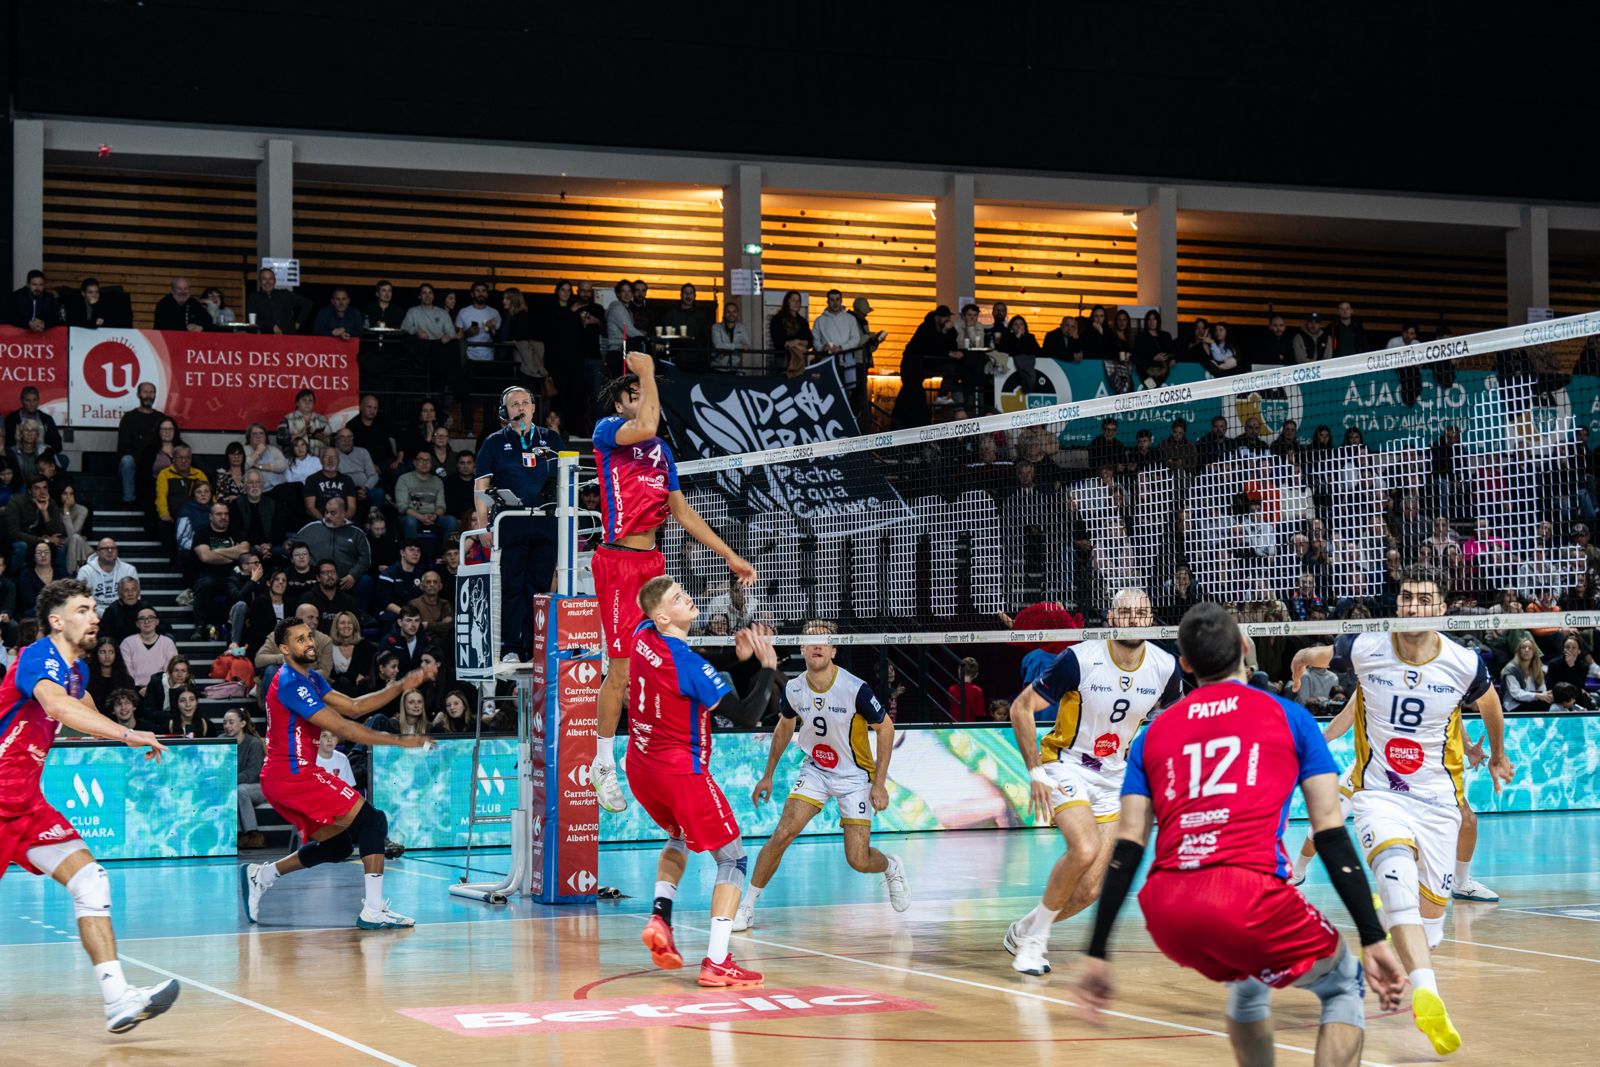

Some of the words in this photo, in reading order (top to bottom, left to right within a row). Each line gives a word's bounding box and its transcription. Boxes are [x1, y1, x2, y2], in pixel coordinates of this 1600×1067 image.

[1425, 340, 1469, 360] CORSICA
[186, 350, 243, 365] PALAIS
[249, 352, 281, 366] DES
[286, 353, 348, 369] SPORTS
[1292, 366, 1321, 382] CORSE
[184, 371, 203, 386] ET
[210, 372, 243, 387] DES
[248, 374, 349, 391] SPECTACLES
[1159, 387, 1192, 404] CORSICA
[1057, 405, 1080, 419] CORSE
[954, 422, 980, 436] CORSICA
[875, 435, 893, 447] CORSE
[648, 444, 662, 468] 4
[792, 447, 814, 459] CORSICA
[772, 464, 845, 484] Pêche
[319, 481, 344, 492] PEAK
[562, 600, 599, 609] Carrefour
[1341, 621, 1364, 633] Gamm
[1365, 620, 1380, 632] vert
[1447, 617, 1472, 630] Gamm
[1473, 617, 1490, 630] vert
[1564, 613, 1591, 627] Gamm
[568, 632, 598, 640] AJACCIO
[1010, 631, 1025, 642] Gamm
[1027, 631, 1037, 641] vert
[1082, 629, 1098, 641] Gamm
[1100, 629, 1112, 640] vert
[1247, 625, 1267, 636] Gamm
[1269, 624, 1282, 635] vert
[613, 638, 621, 652] 4
[570, 695, 596, 703] market
[1110, 698, 1130, 723] 8
[1187, 696, 1239, 719] PATAK
[1389, 695, 1425, 727] 18
[566, 727, 588, 737] Albert
[813, 716, 827, 737] 9
[1390, 746, 1419, 754] FRUITS
[1182, 736, 1241, 799] 12
[340, 786, 355, 800] 10
[564, 790, 598, 798] Carrefou
[569, 798, 596, 806] market
[858, 802, 866, 813] 9
[70, 816, 100, 826] CLUB
[568, 824, 599, 832] AJACCIO
[724, 821, 733, 835] 1
[566, 834, 589, 842] Albert
[591, 834, 599, 842] 1e
[453, 993, 885, 1029] Betclic
